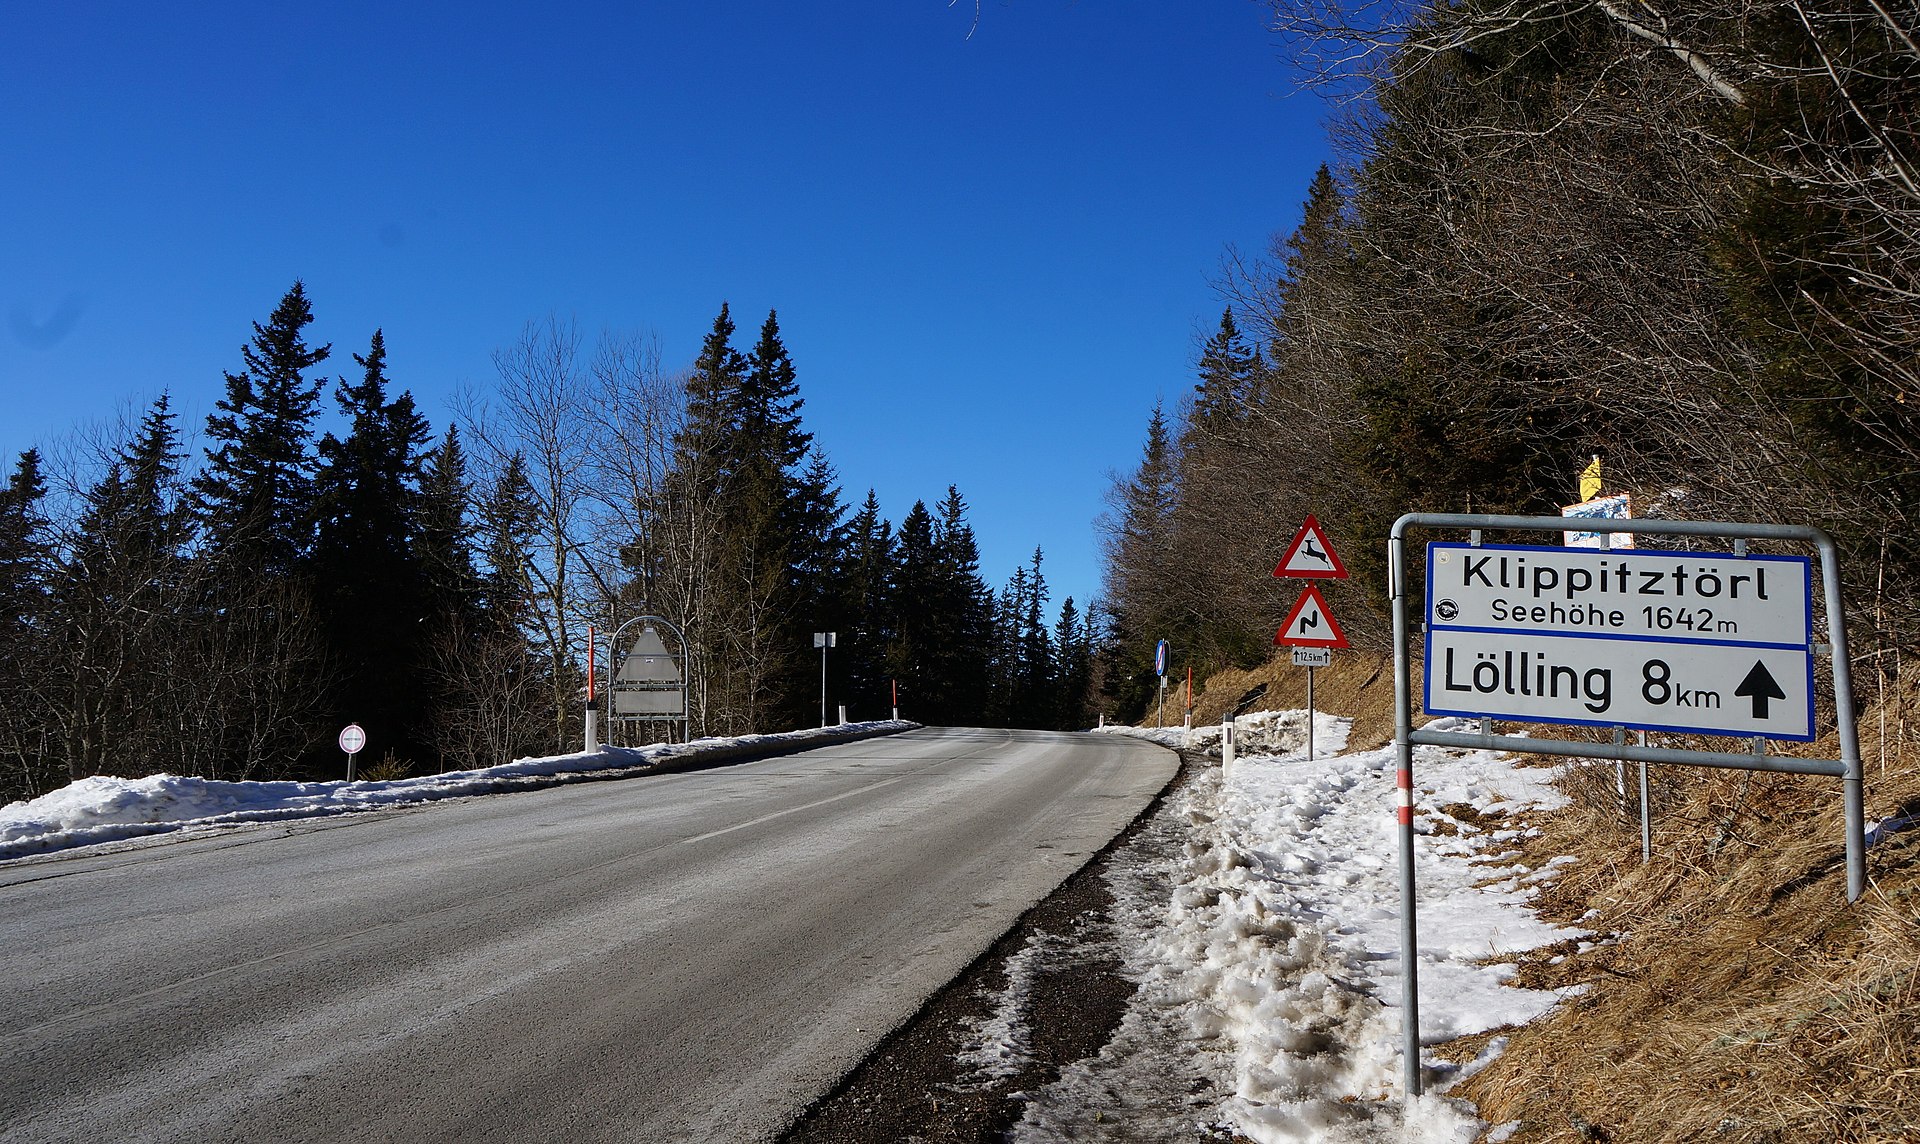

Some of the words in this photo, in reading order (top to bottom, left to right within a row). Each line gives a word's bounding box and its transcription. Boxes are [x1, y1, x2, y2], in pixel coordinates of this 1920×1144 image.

[1463, 555, 1769, 601] Klippitztörl
[1491, 598, 1625, 628] Seehöhe
[1445, 647, 1612, 714] Lölling
